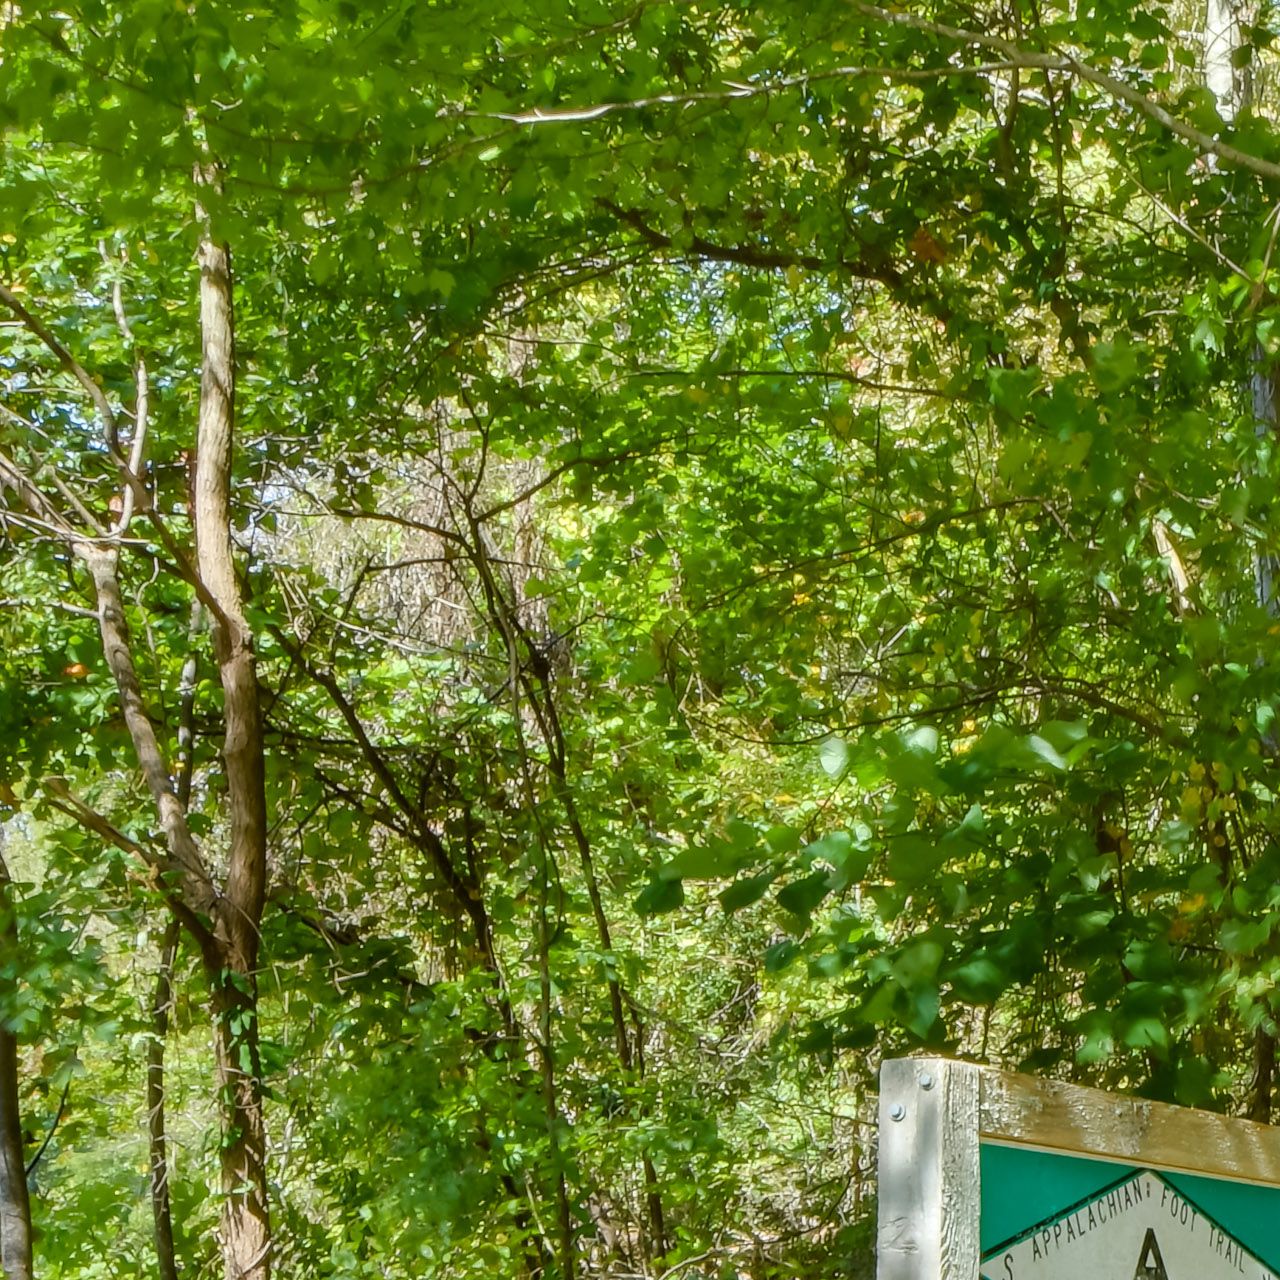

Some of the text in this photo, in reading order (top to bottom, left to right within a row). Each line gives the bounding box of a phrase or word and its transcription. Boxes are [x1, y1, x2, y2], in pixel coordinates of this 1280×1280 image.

[1032, 1177, 1245, 1274] APPALACHIAN FOOT TRAIL
